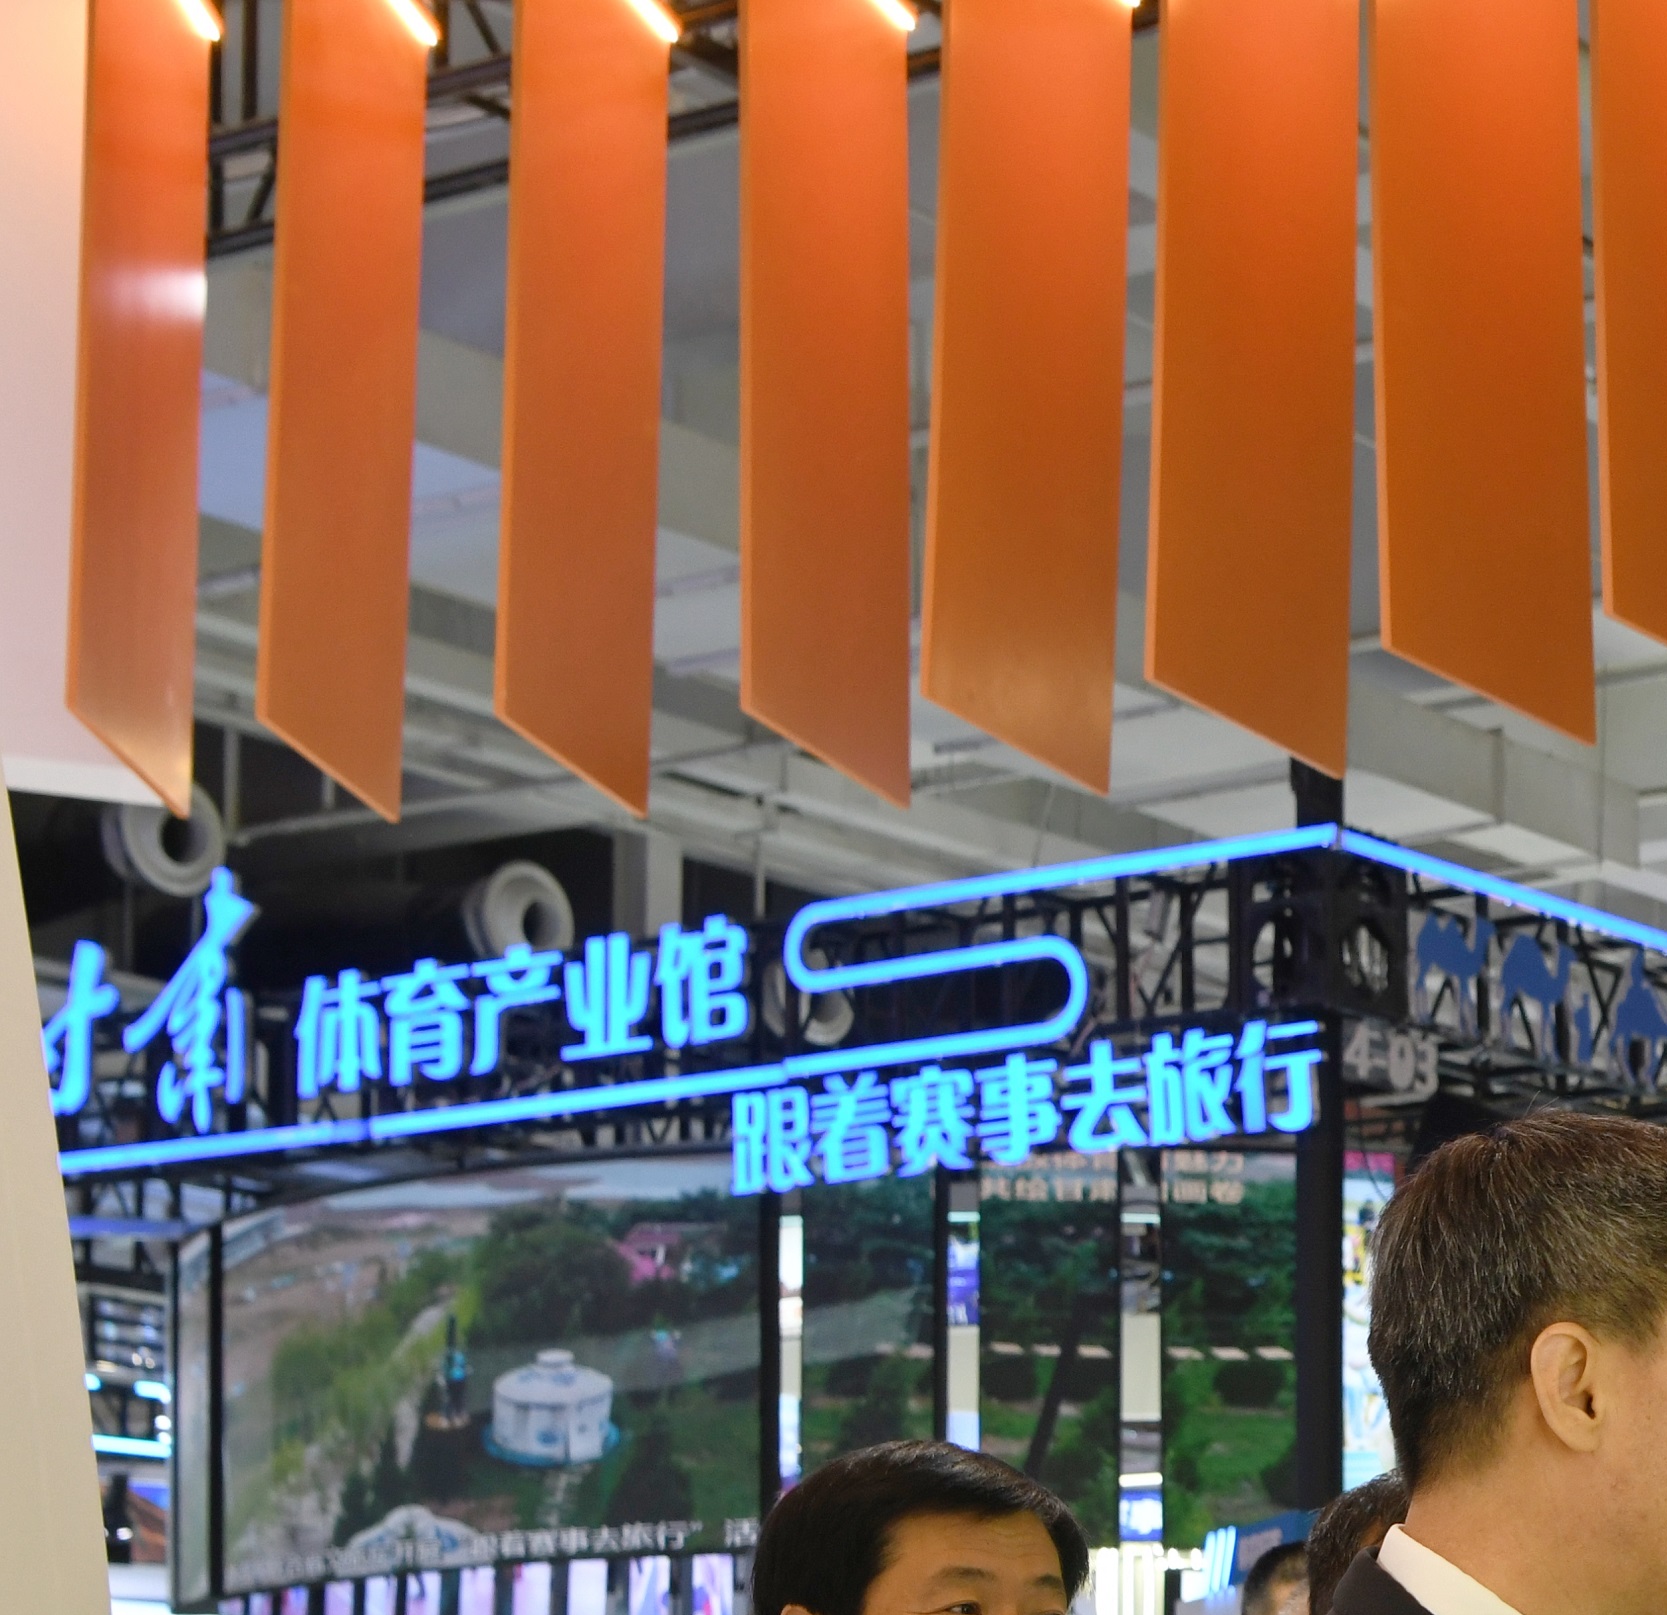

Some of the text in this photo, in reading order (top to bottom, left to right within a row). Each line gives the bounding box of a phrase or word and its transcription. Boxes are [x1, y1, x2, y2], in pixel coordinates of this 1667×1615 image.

[293, 913, 749, 1100] 体育产业馆
[729, 1018, 1326, 1198] 跟着赛事去旅行
